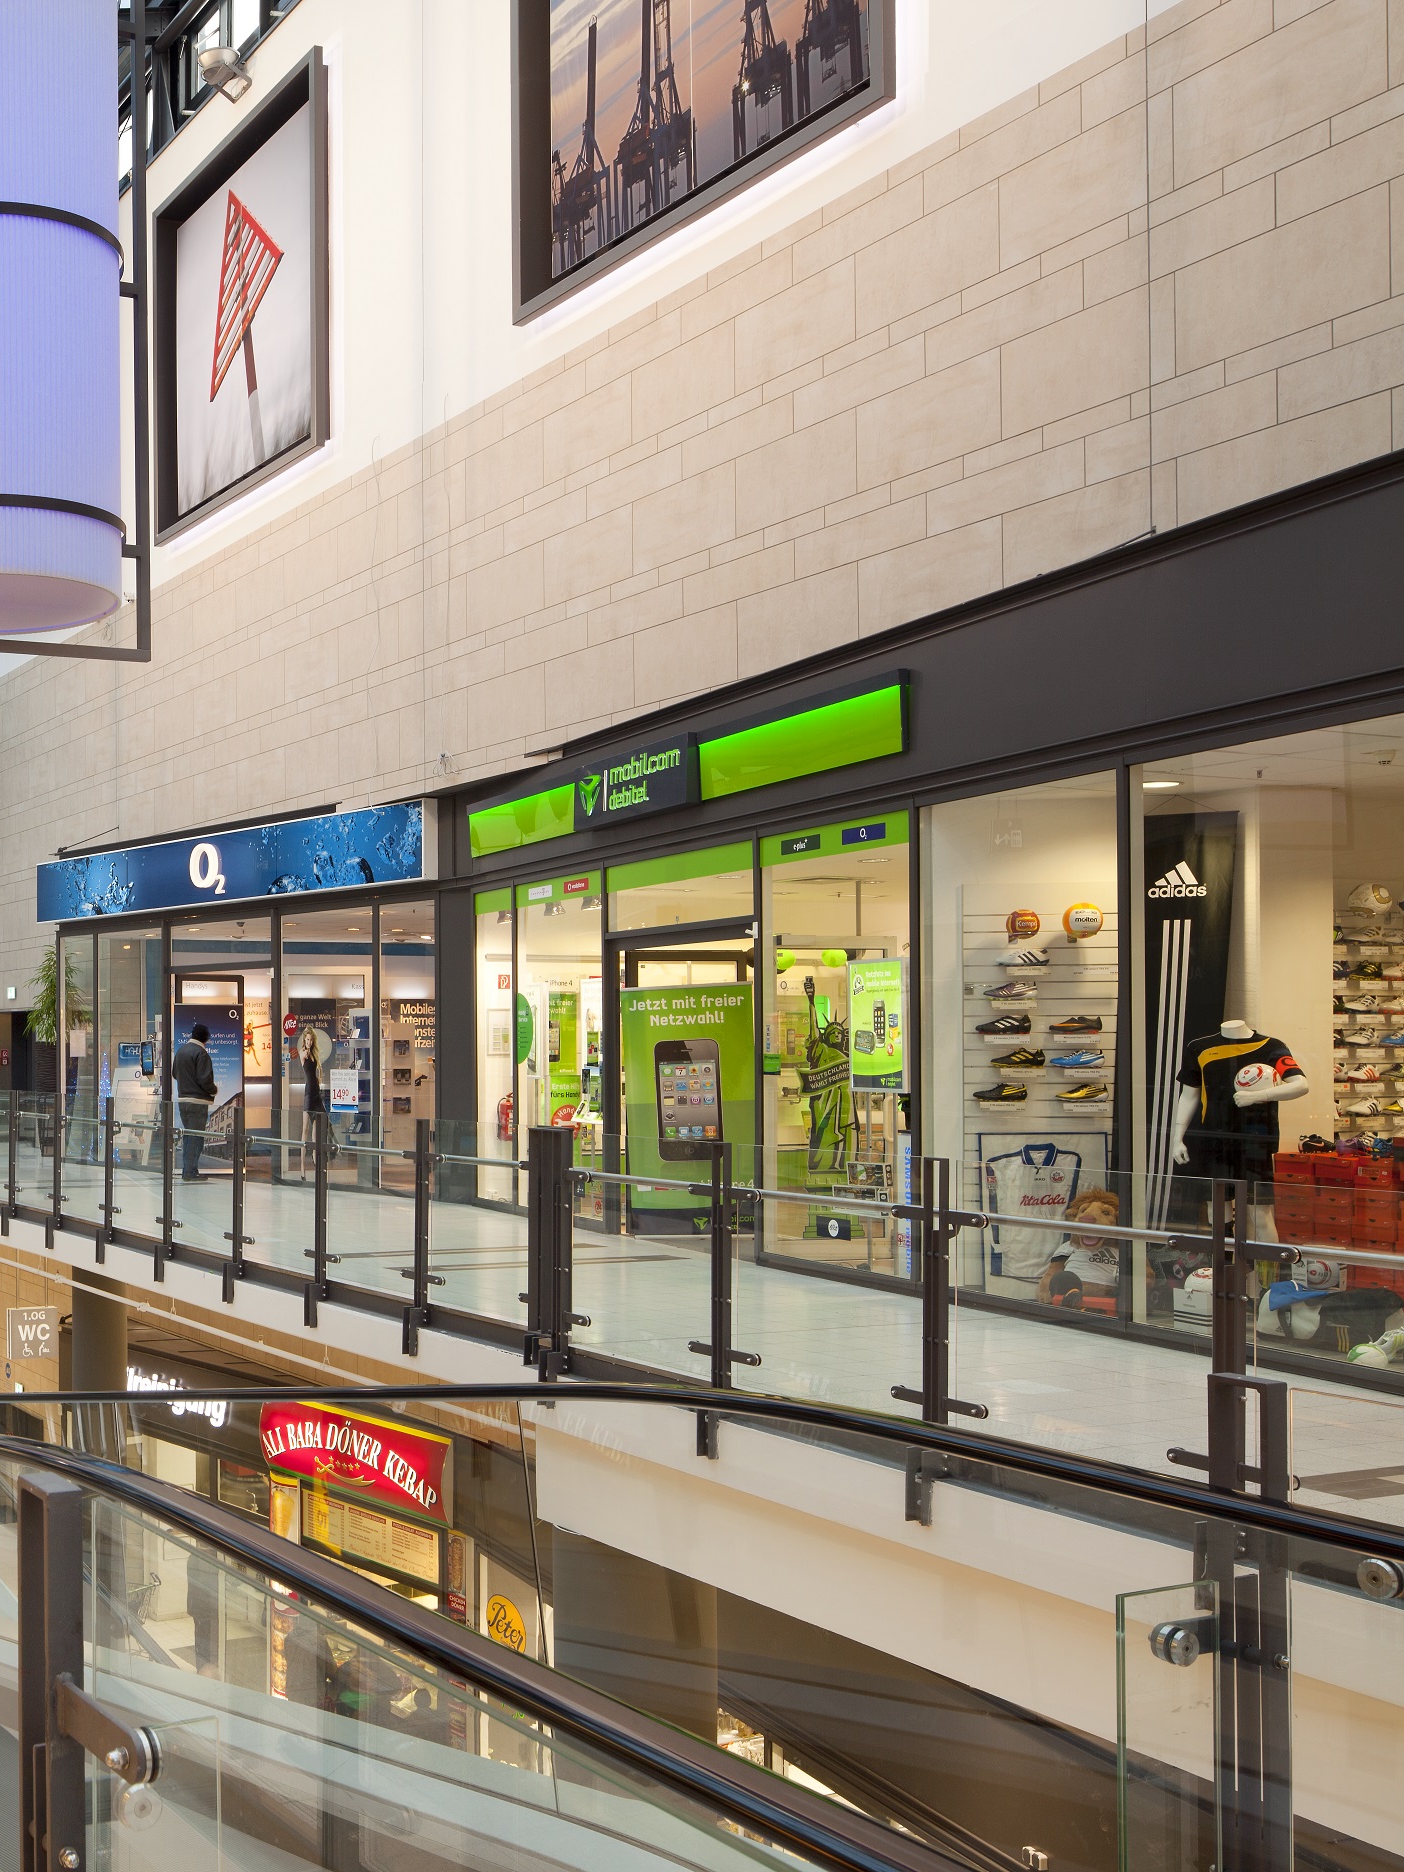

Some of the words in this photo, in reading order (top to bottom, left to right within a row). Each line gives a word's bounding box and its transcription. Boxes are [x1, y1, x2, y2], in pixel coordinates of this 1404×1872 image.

[609, 748, 681, 785] mobilcom
[608, 780, 650, 811] debitel
[859, 827, 867, 840] O2
[189, 842, 226, 895] O2
[1147, 884, 1207, 899] adidas
[628, 998, 668, 1012] Jetzt
[672, 996, 697, 1009] mit
[701, 994, 745, 1008] freier
[228, 1009, 240, 1020] O2
[649, 1011, 725, 1026] Netzwahl!
[22, 1310, 46, 1321] 1.OG
[17, 1323, 51, 1342] WC
[262, 1426, 287, 1459] ALI
[285, 1421, 324, 1451] BABA
[325, 1420, 383, 1470] DÖNER
[382, 1449, 438, 1511] KEBAP
[487, 1601, 525, 1651] Peter
